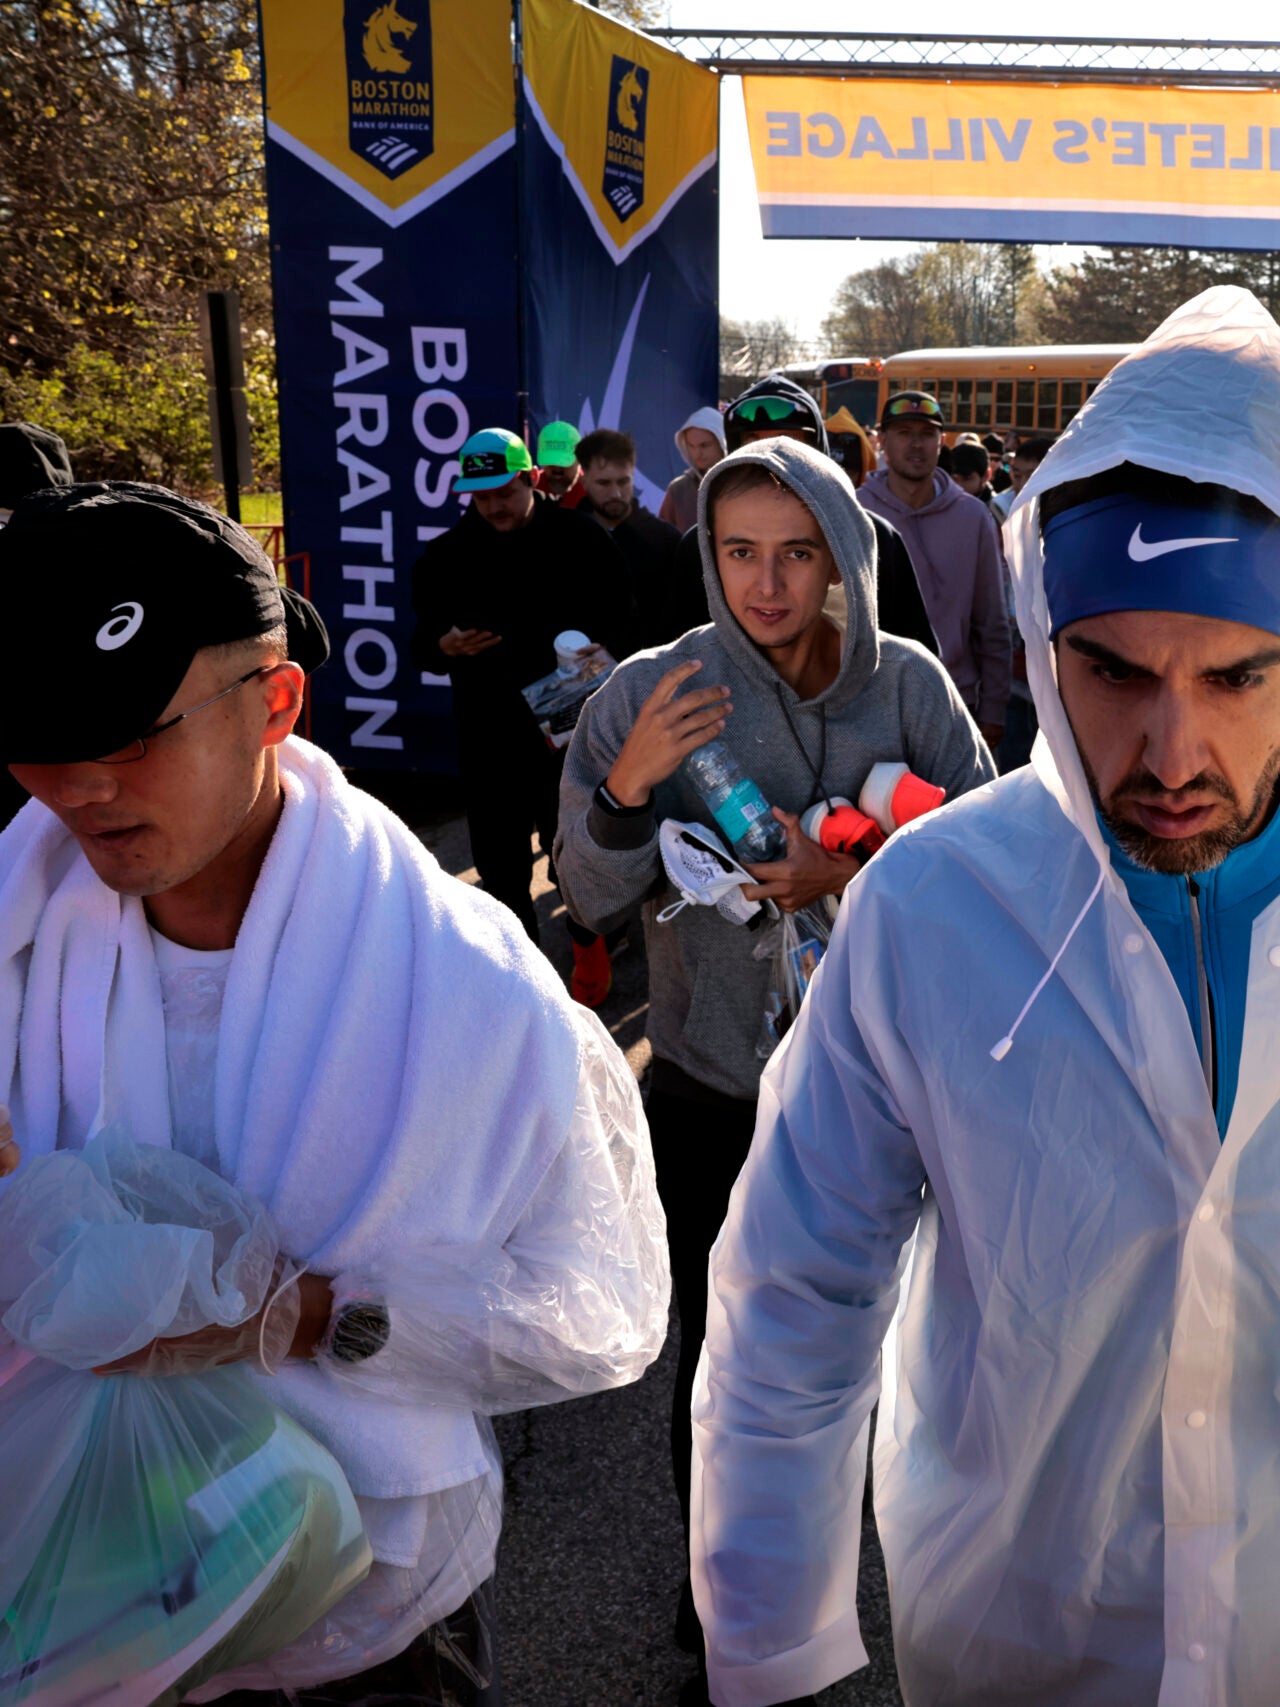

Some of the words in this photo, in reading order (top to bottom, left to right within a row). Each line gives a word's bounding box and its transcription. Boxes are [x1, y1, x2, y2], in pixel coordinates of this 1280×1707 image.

[351, 80, 430, 100] BOSTON
[352, 102, 430, 117] MARATHON
[353, 121, 375, 129] BANK
[377, 121, 388, 130] OF
[390, 121, 429, 131] AMERICA
[608, 130, 644, 157] BOSTON
[328, 245, 404, 750] MARATHON
